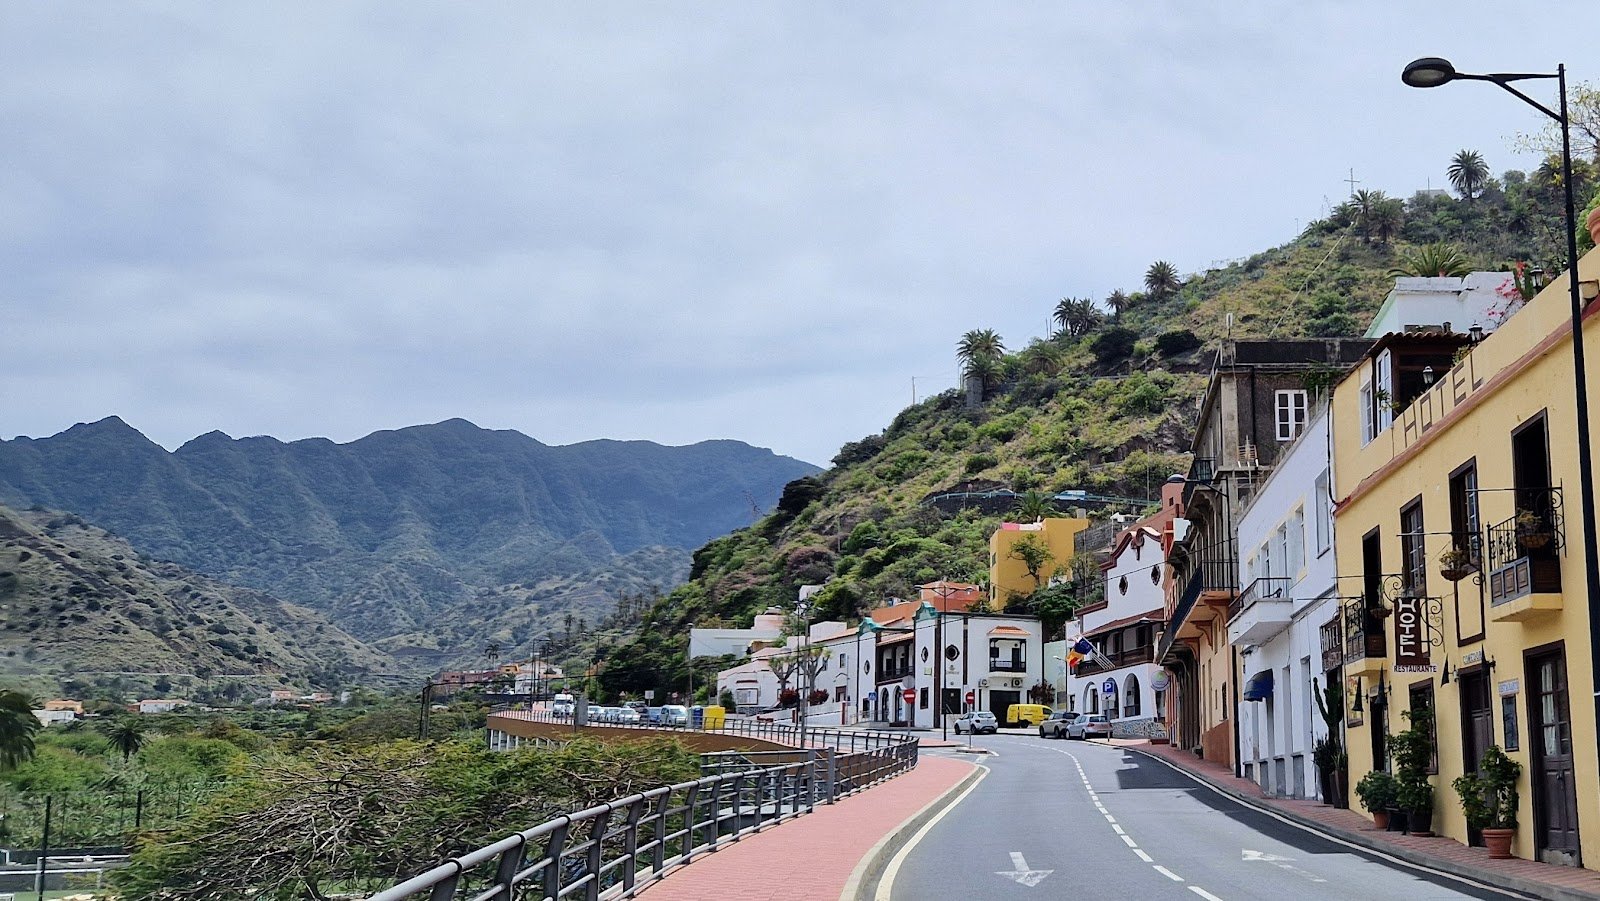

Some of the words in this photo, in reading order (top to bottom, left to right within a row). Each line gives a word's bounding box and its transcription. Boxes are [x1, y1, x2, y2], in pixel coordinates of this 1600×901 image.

[1403, 353, 1483, 448] HOTEL
[1398, 599, 1417, 656] HOTEL
[1393, 665, 1437, 673] RESTAURANTE
[1104, 683, 1111, 691] P
